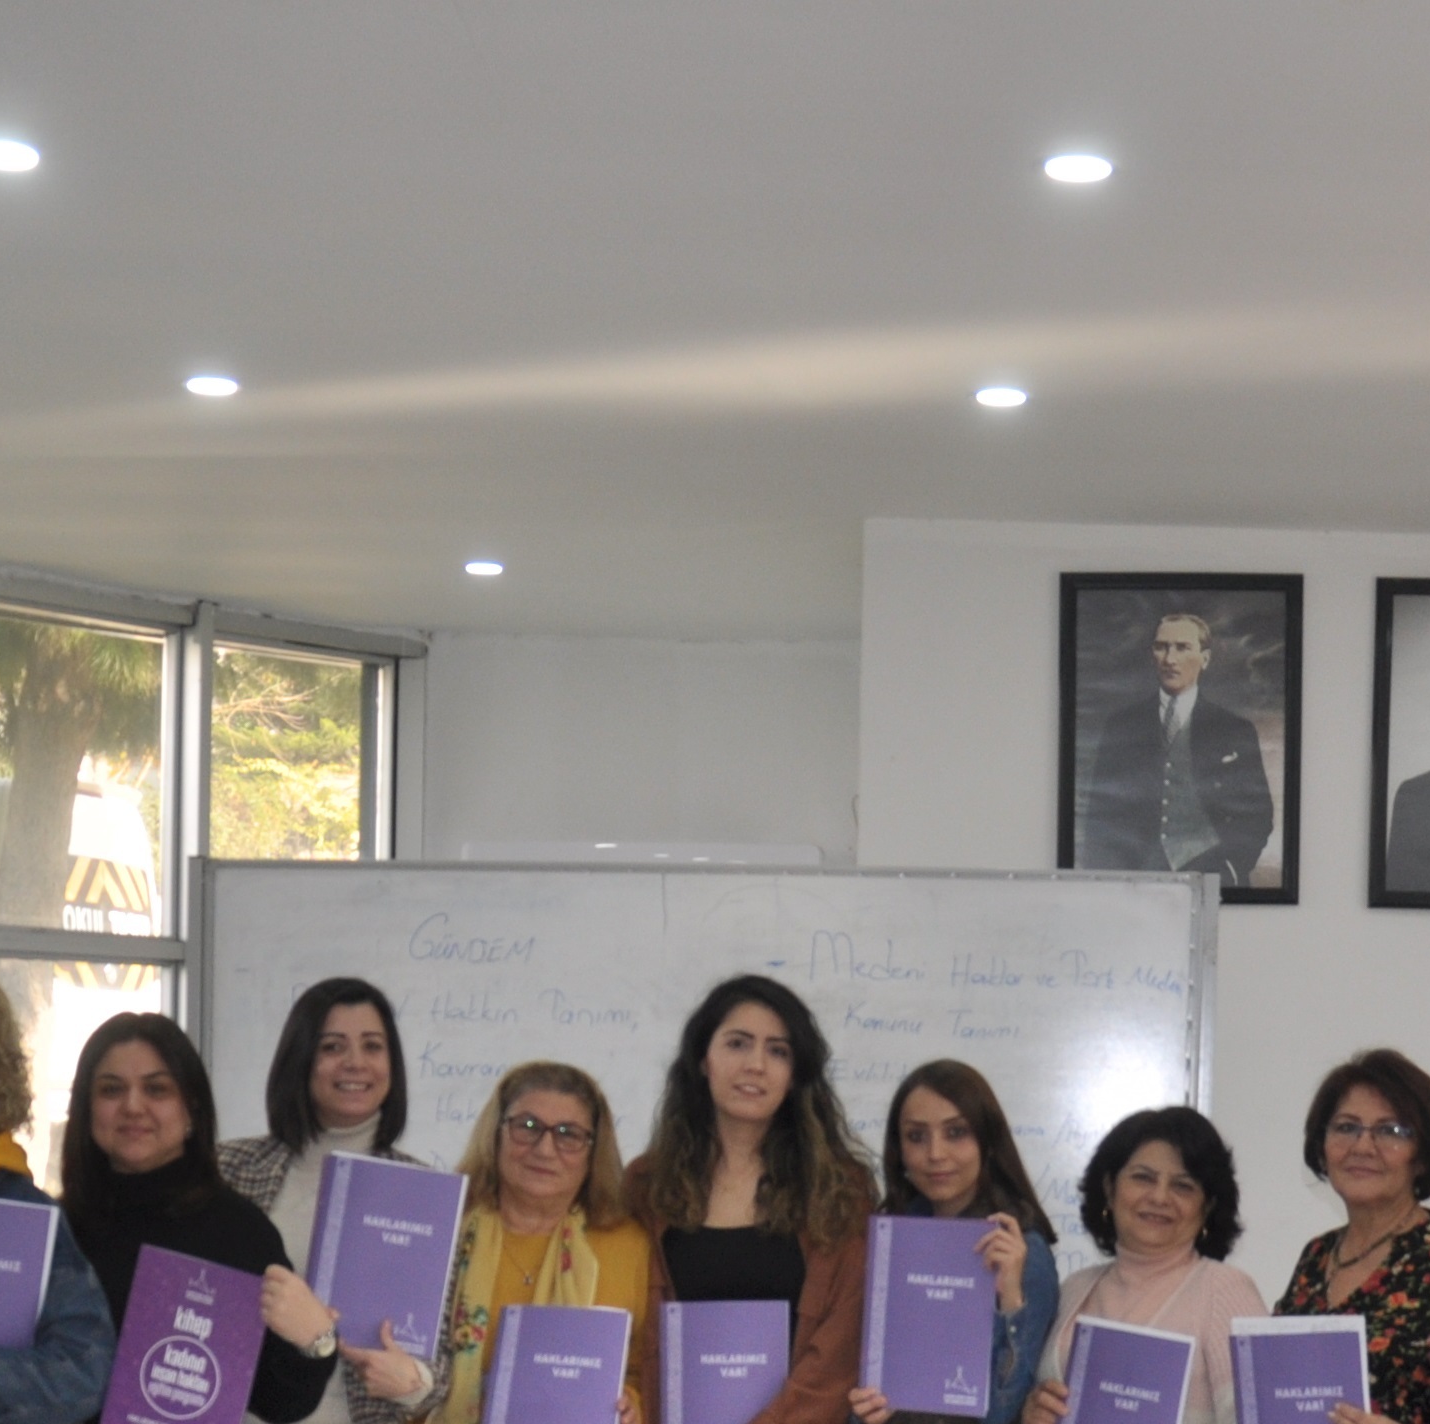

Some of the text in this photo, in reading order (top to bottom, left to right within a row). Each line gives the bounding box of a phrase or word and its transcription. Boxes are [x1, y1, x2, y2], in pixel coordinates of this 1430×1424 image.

[906, 1273, 975, 1289] HAKLARIMIZ
[1274, 1385, 1344, 1399] HAKLARIMIZ
[1295, 1399, 1325, 1413] VAR!
